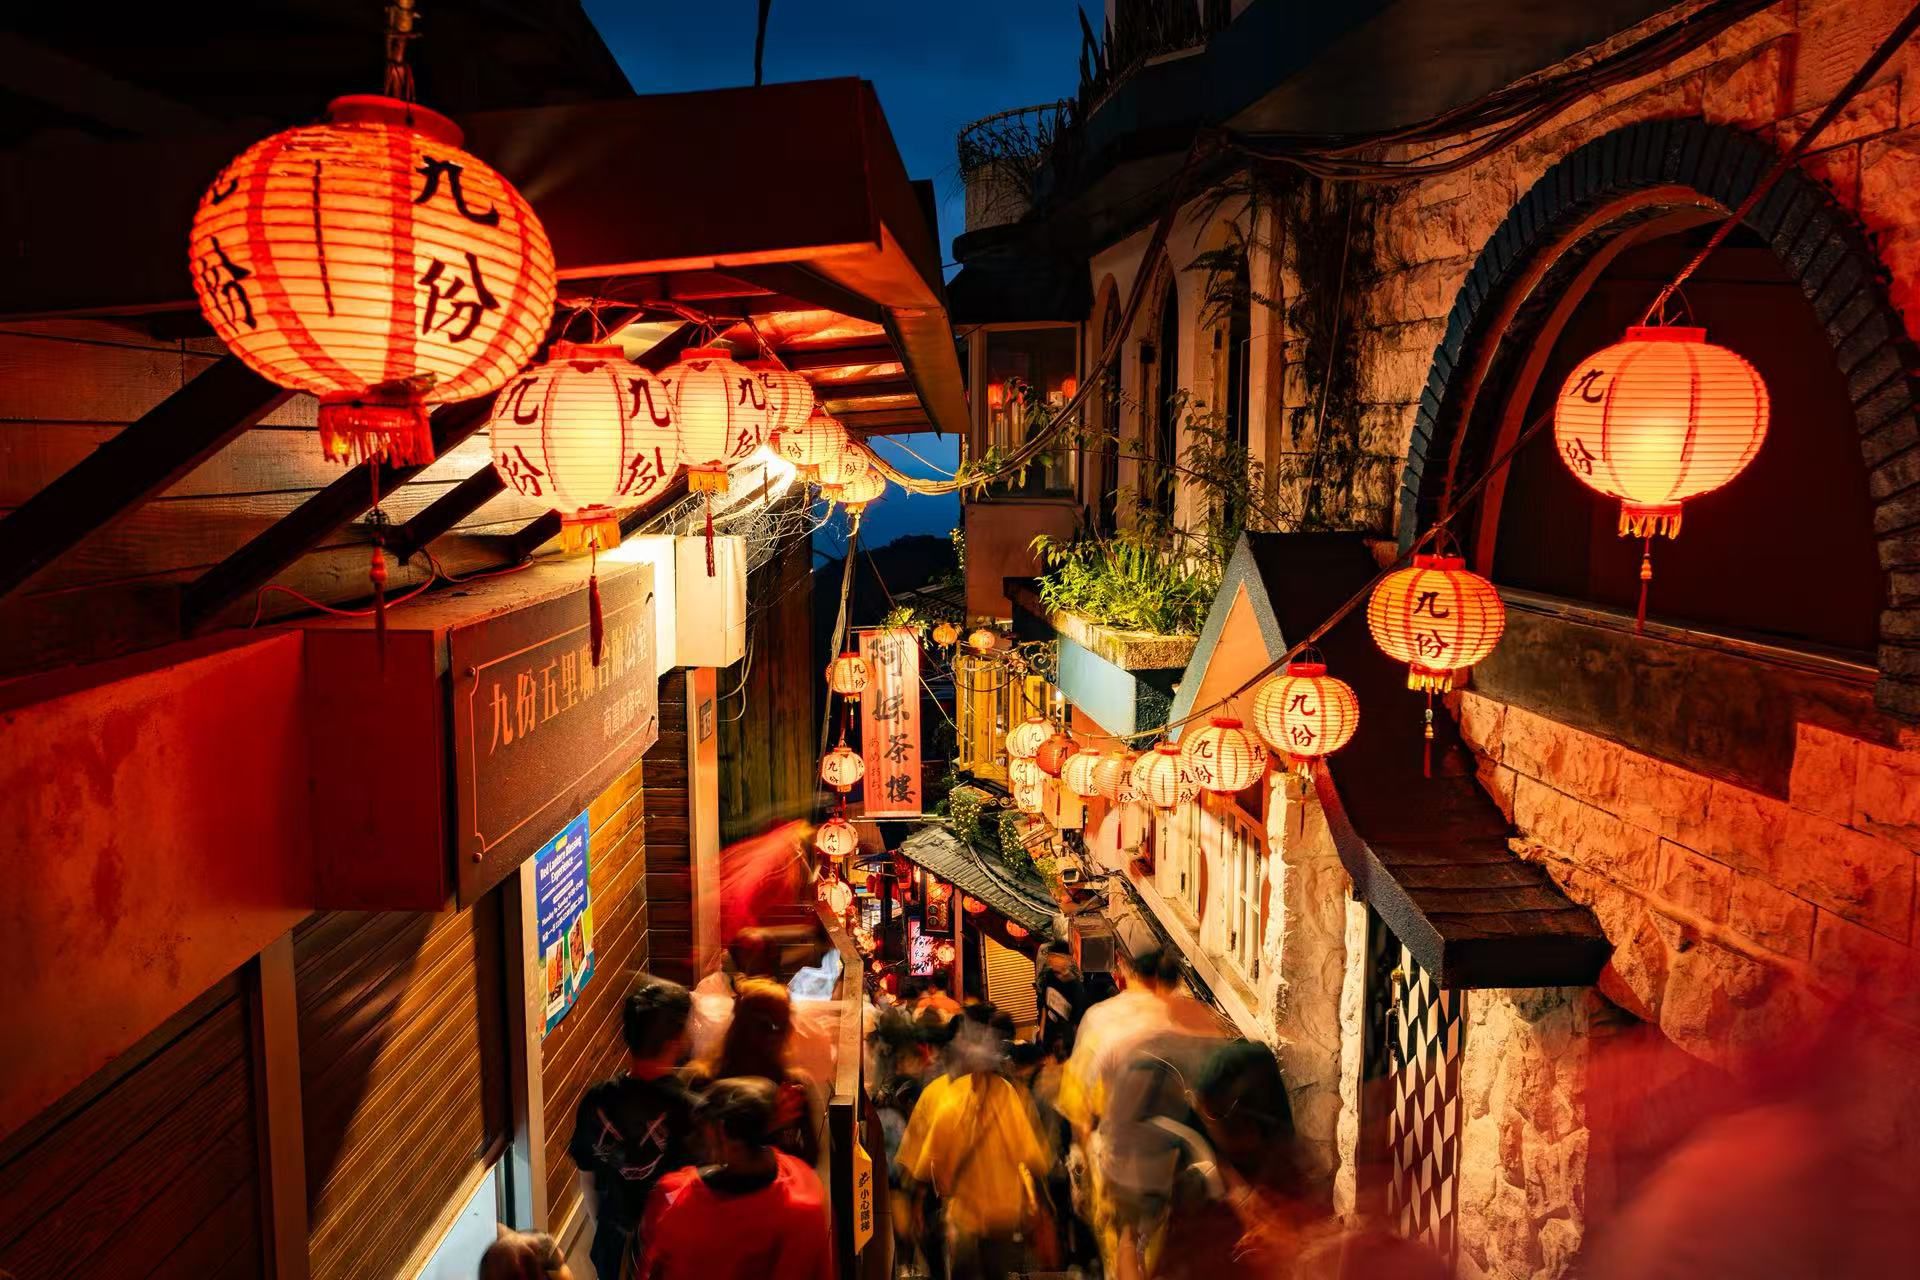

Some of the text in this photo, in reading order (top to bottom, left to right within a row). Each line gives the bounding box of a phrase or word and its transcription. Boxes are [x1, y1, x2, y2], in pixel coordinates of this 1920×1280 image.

[414, 155, 500, 343] 九份
[498, 375, 545, 498] 九份
[620, 376, 672, 497] 九份
[730, 376, 767, 459] 九份
[1565, 367, 1606, 477] 九份
[1411, 590, 1450, 660] 九份
[853, 663, 867, 689] 九份
[1287, 693, 1318, 748] 九份
[828, 760, 839, 784] 九份
[1178, 768, 1195, 804] 九份
[1192, 739, 1215, 785] 九份
[550, 856, 574, 884] Experience
